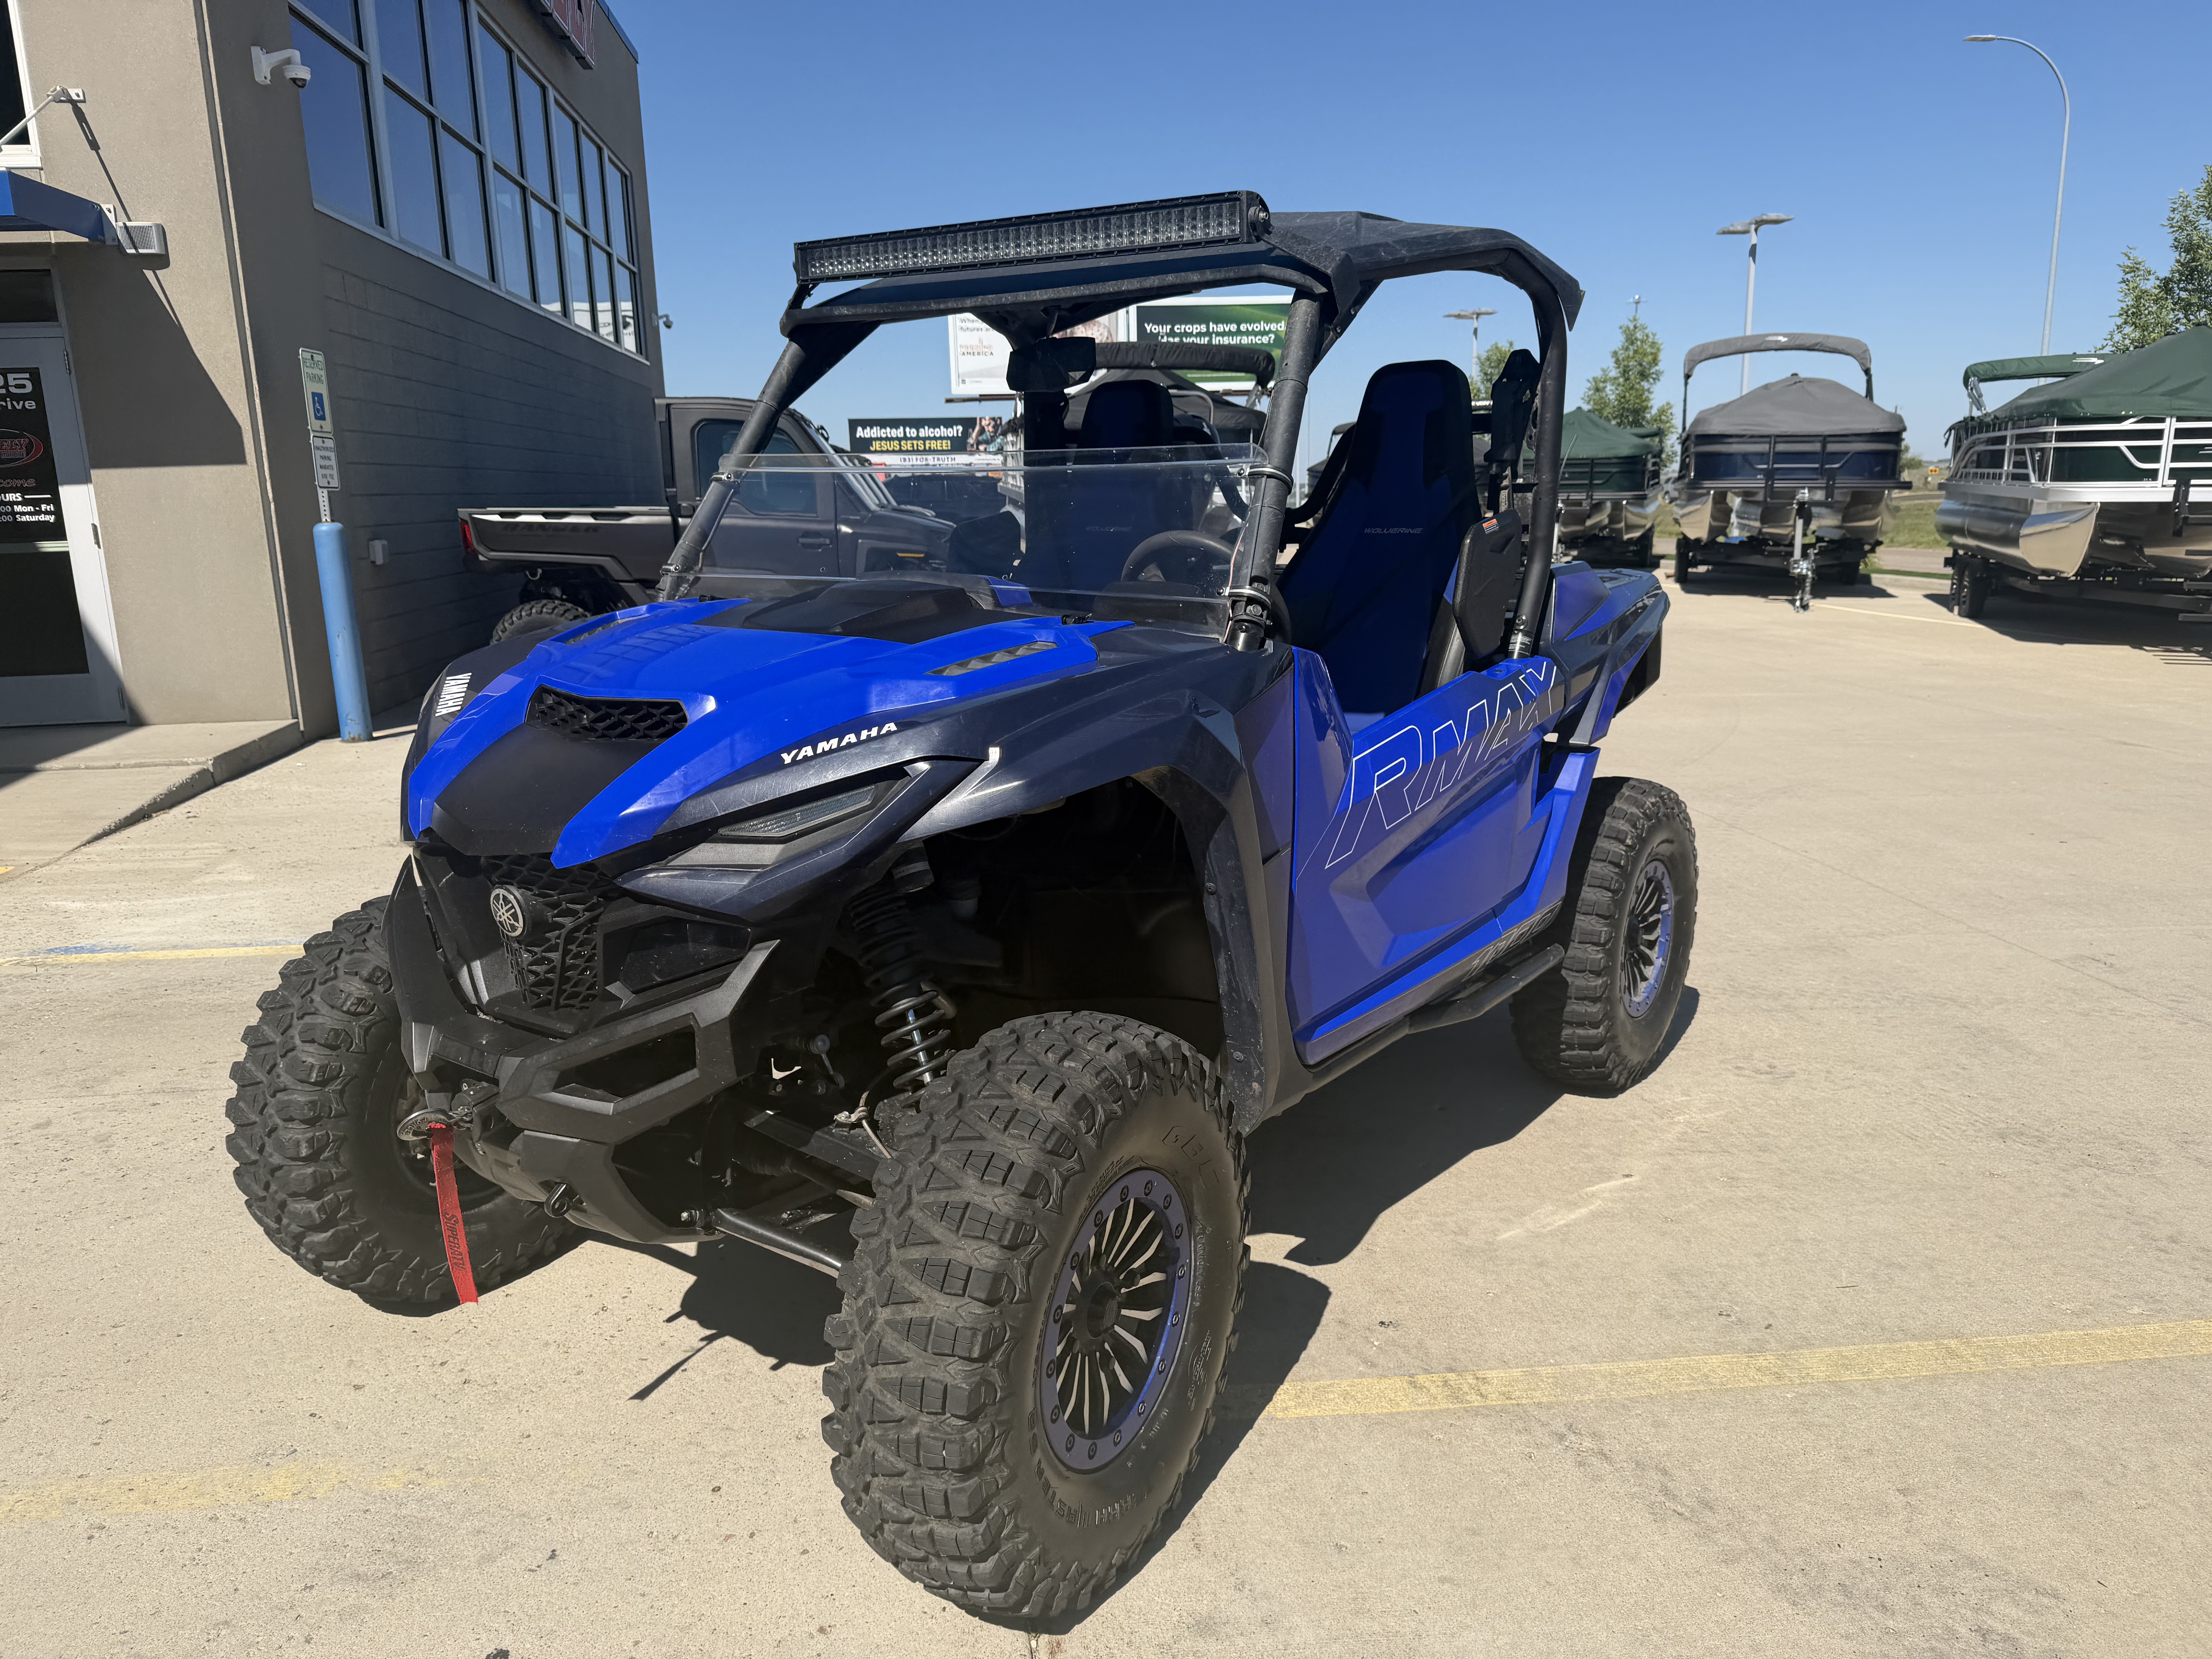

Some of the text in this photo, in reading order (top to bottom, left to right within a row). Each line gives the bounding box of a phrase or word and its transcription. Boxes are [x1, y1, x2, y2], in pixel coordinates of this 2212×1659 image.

[1145, 322, 1171, 333] Your
[1174, 323, 1207, 334] crops
[1209, 321, 1237, 332] have
[1212, 333, 1275, 345] insurance?
[0, 373, 33, 393] 5
[306, 372, 324, 384] PARKING
[856, 425, 963, 438] Addicted to alcohol?
[870, 440, 951, 451] JESUS SETS FREE!
[0, 493, 23, 501] URS
[15, 514, 55, 523] Saturday
[435, 673, 472, 717] YAMAHA
[780, 721, 898, 764] YAMAHA
[443, 1211, 467, 1270] SUPERATV
